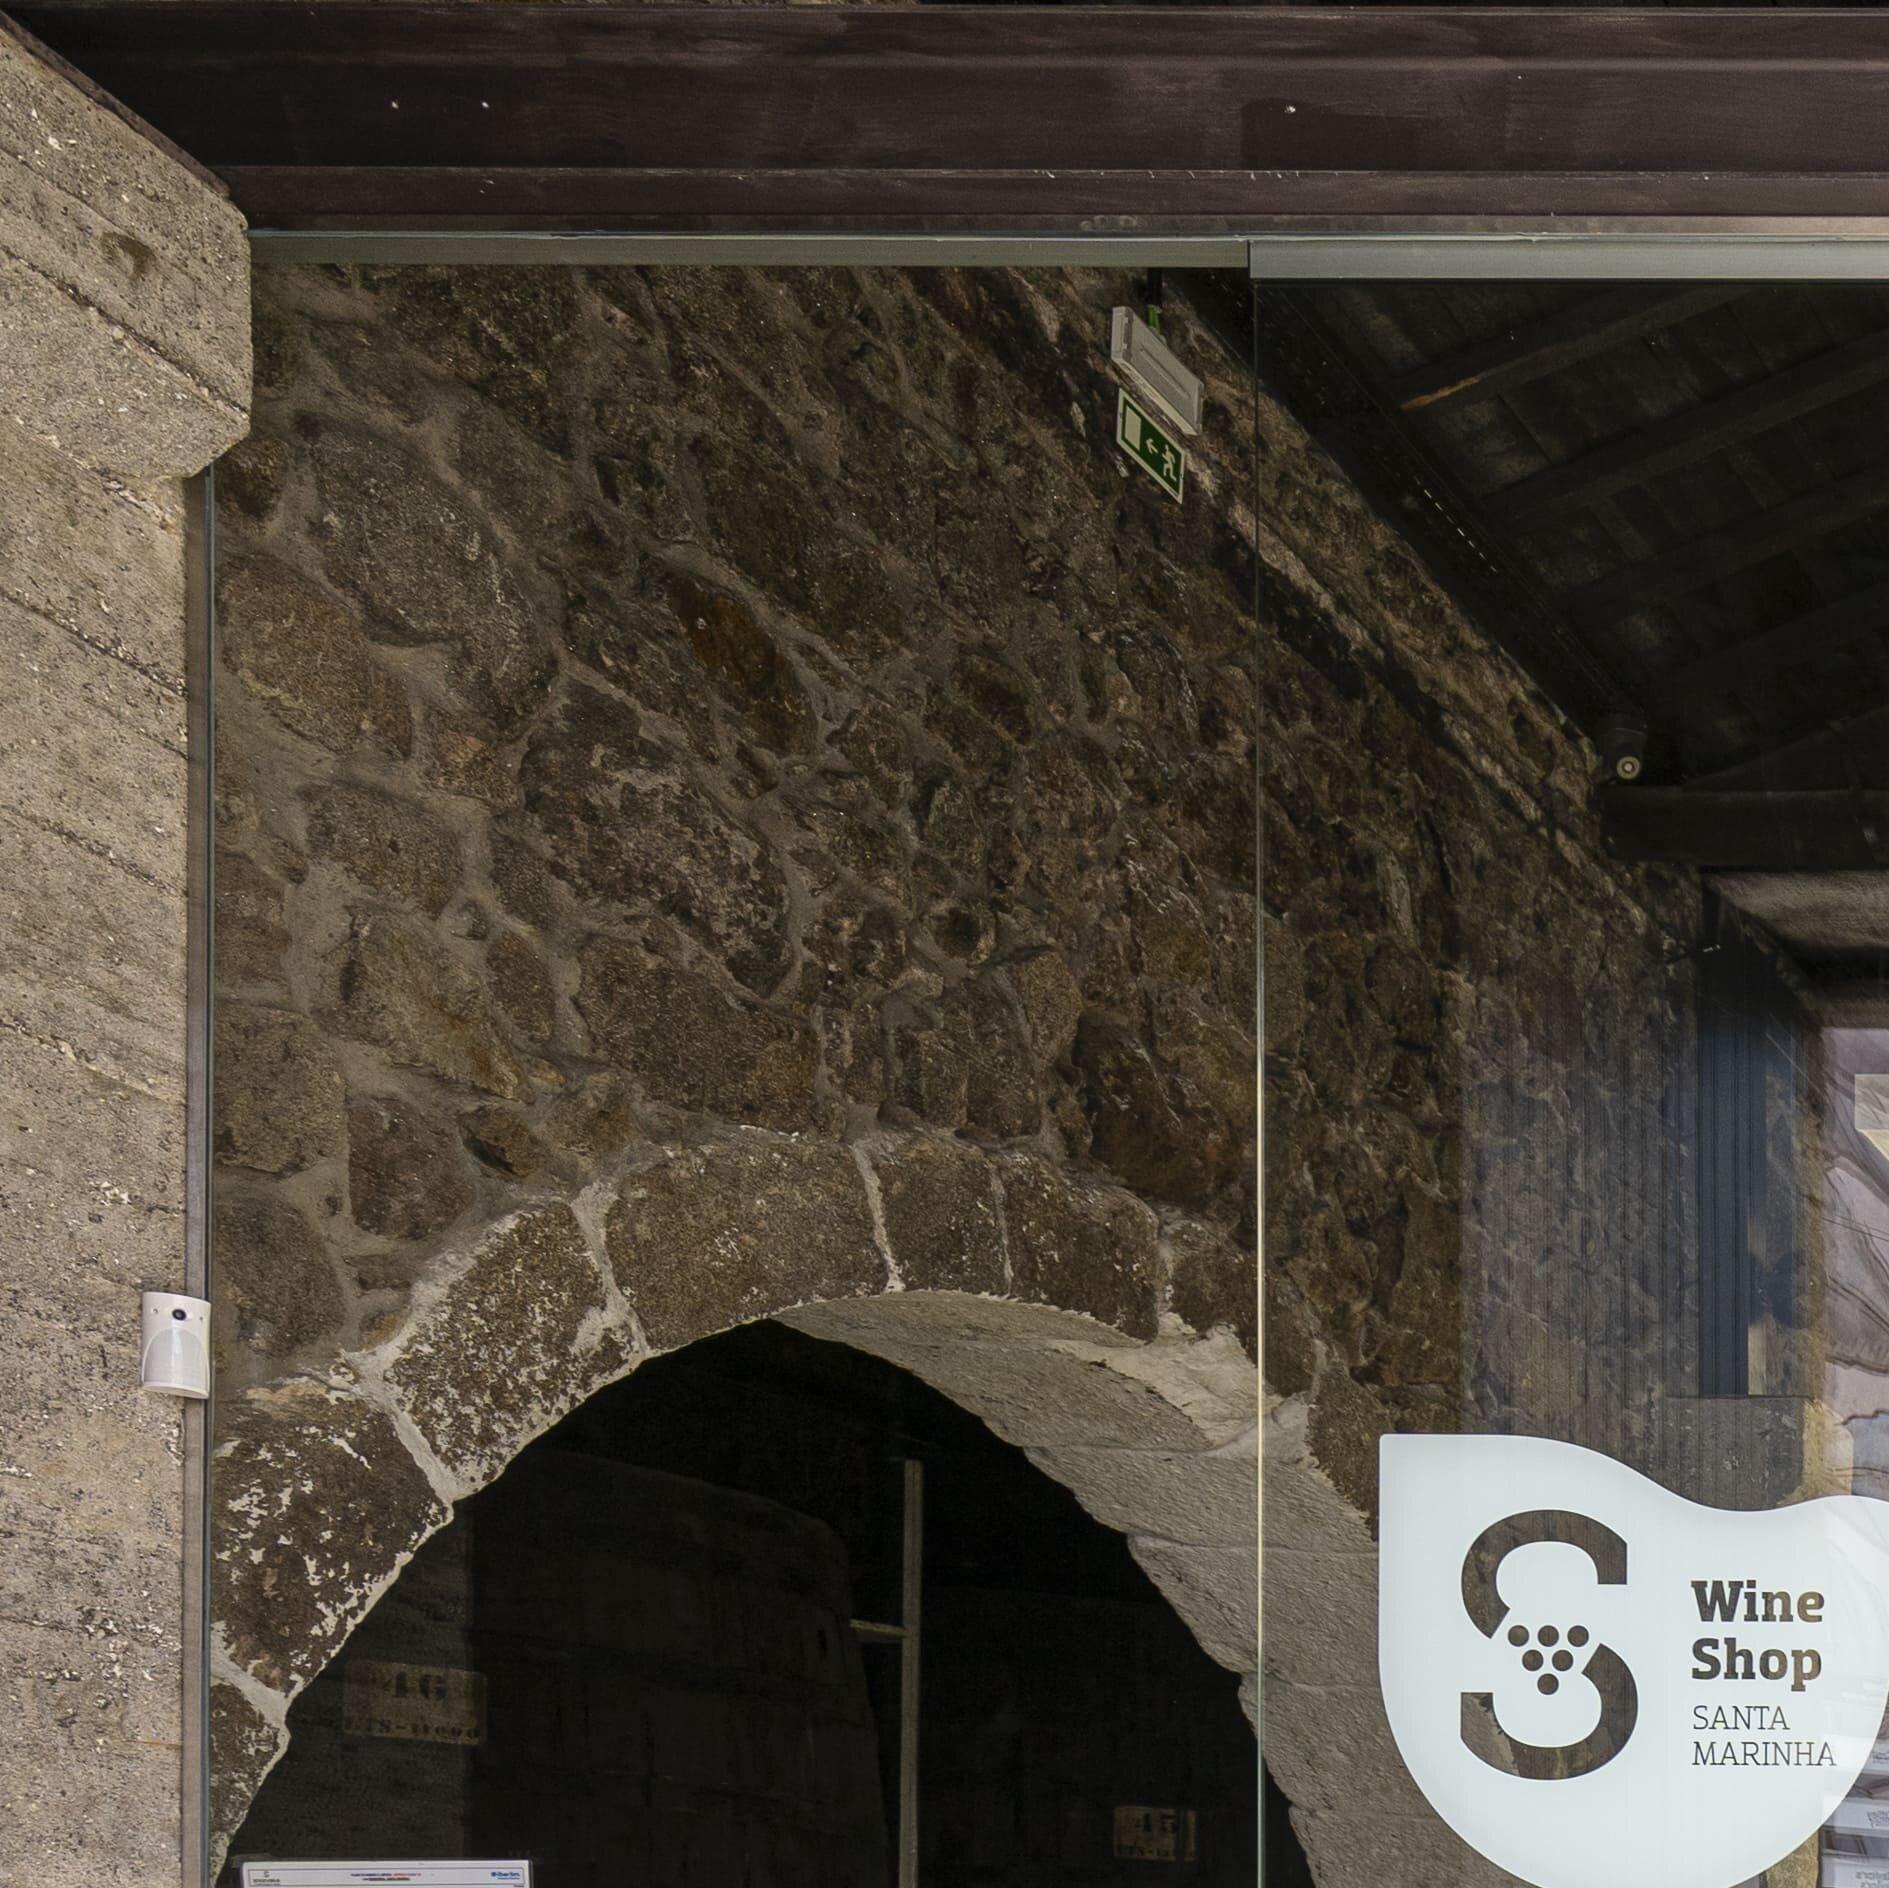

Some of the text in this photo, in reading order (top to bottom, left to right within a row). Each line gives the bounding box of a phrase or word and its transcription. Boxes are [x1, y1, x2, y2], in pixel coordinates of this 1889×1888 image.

[1691, 1579, 1826, 1624] Wine
[1691, 1637, 1823, 1692] Shop
[1692, 1704, 1791, 1731] SANTA
[1691, 1740, 1837, 1767] MARINHA
